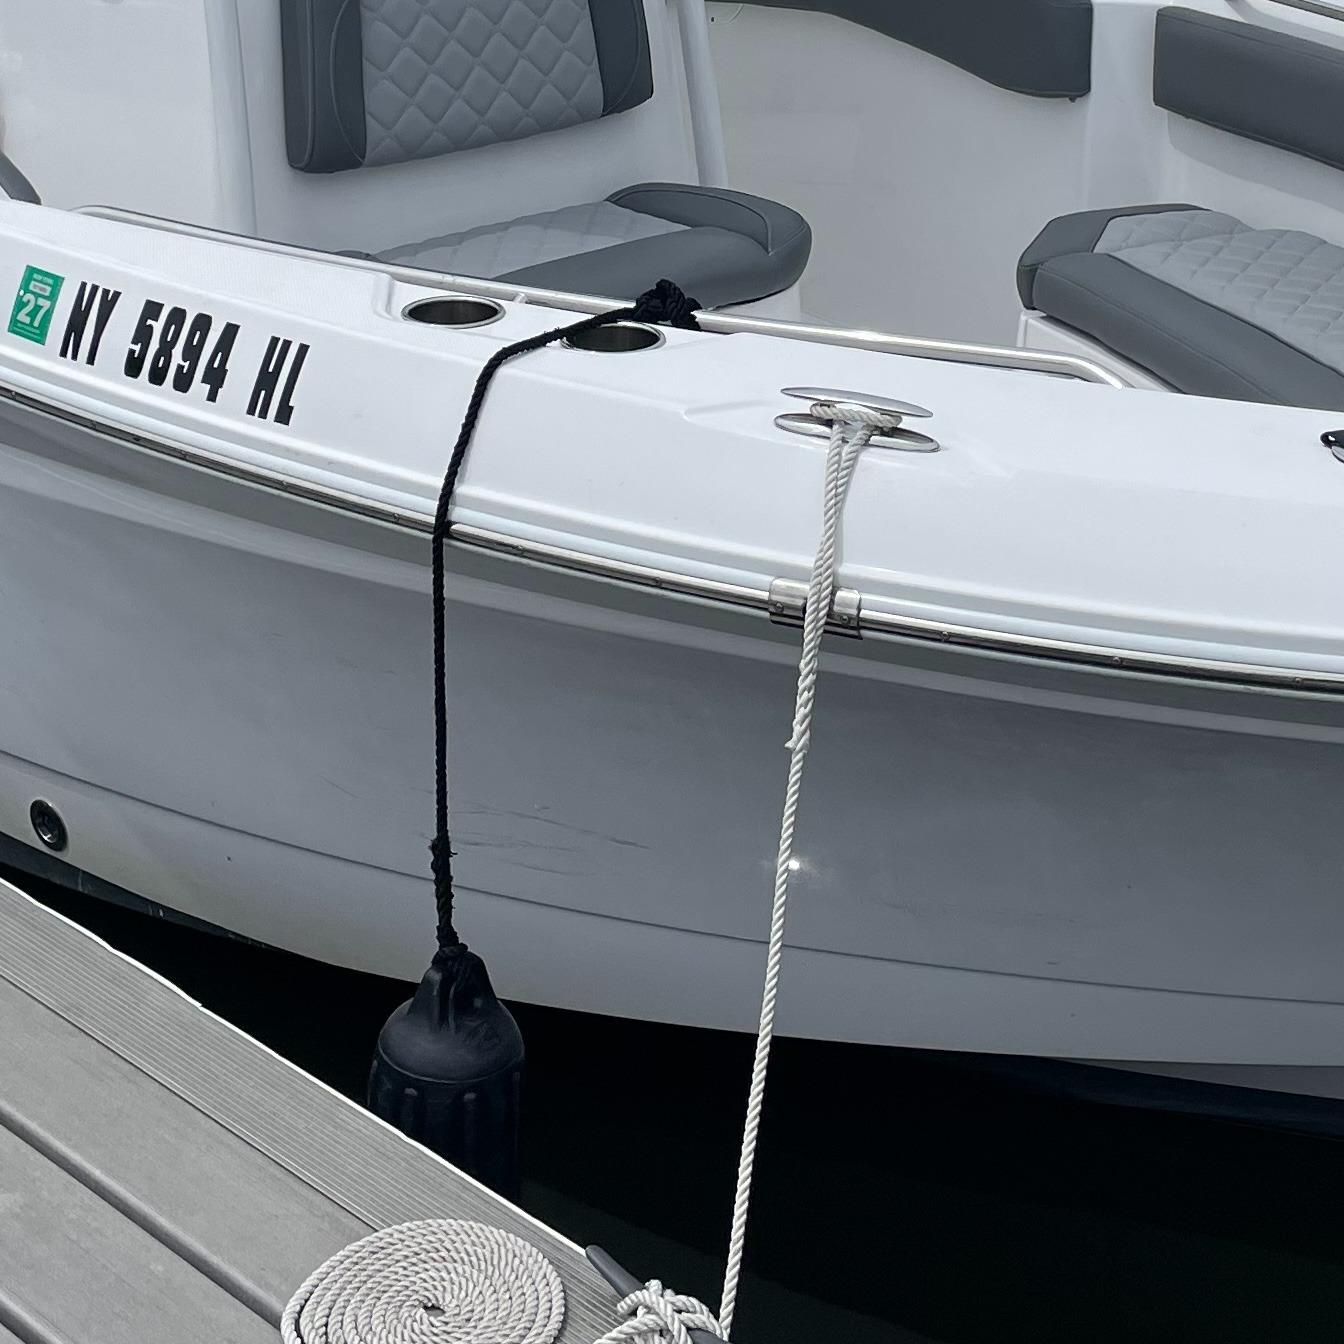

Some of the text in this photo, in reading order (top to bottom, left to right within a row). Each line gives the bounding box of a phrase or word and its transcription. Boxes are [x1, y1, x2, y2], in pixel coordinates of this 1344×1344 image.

[16, 293, 51, 328] 27
[59, 280, 311, 427] NY 5894 HL
